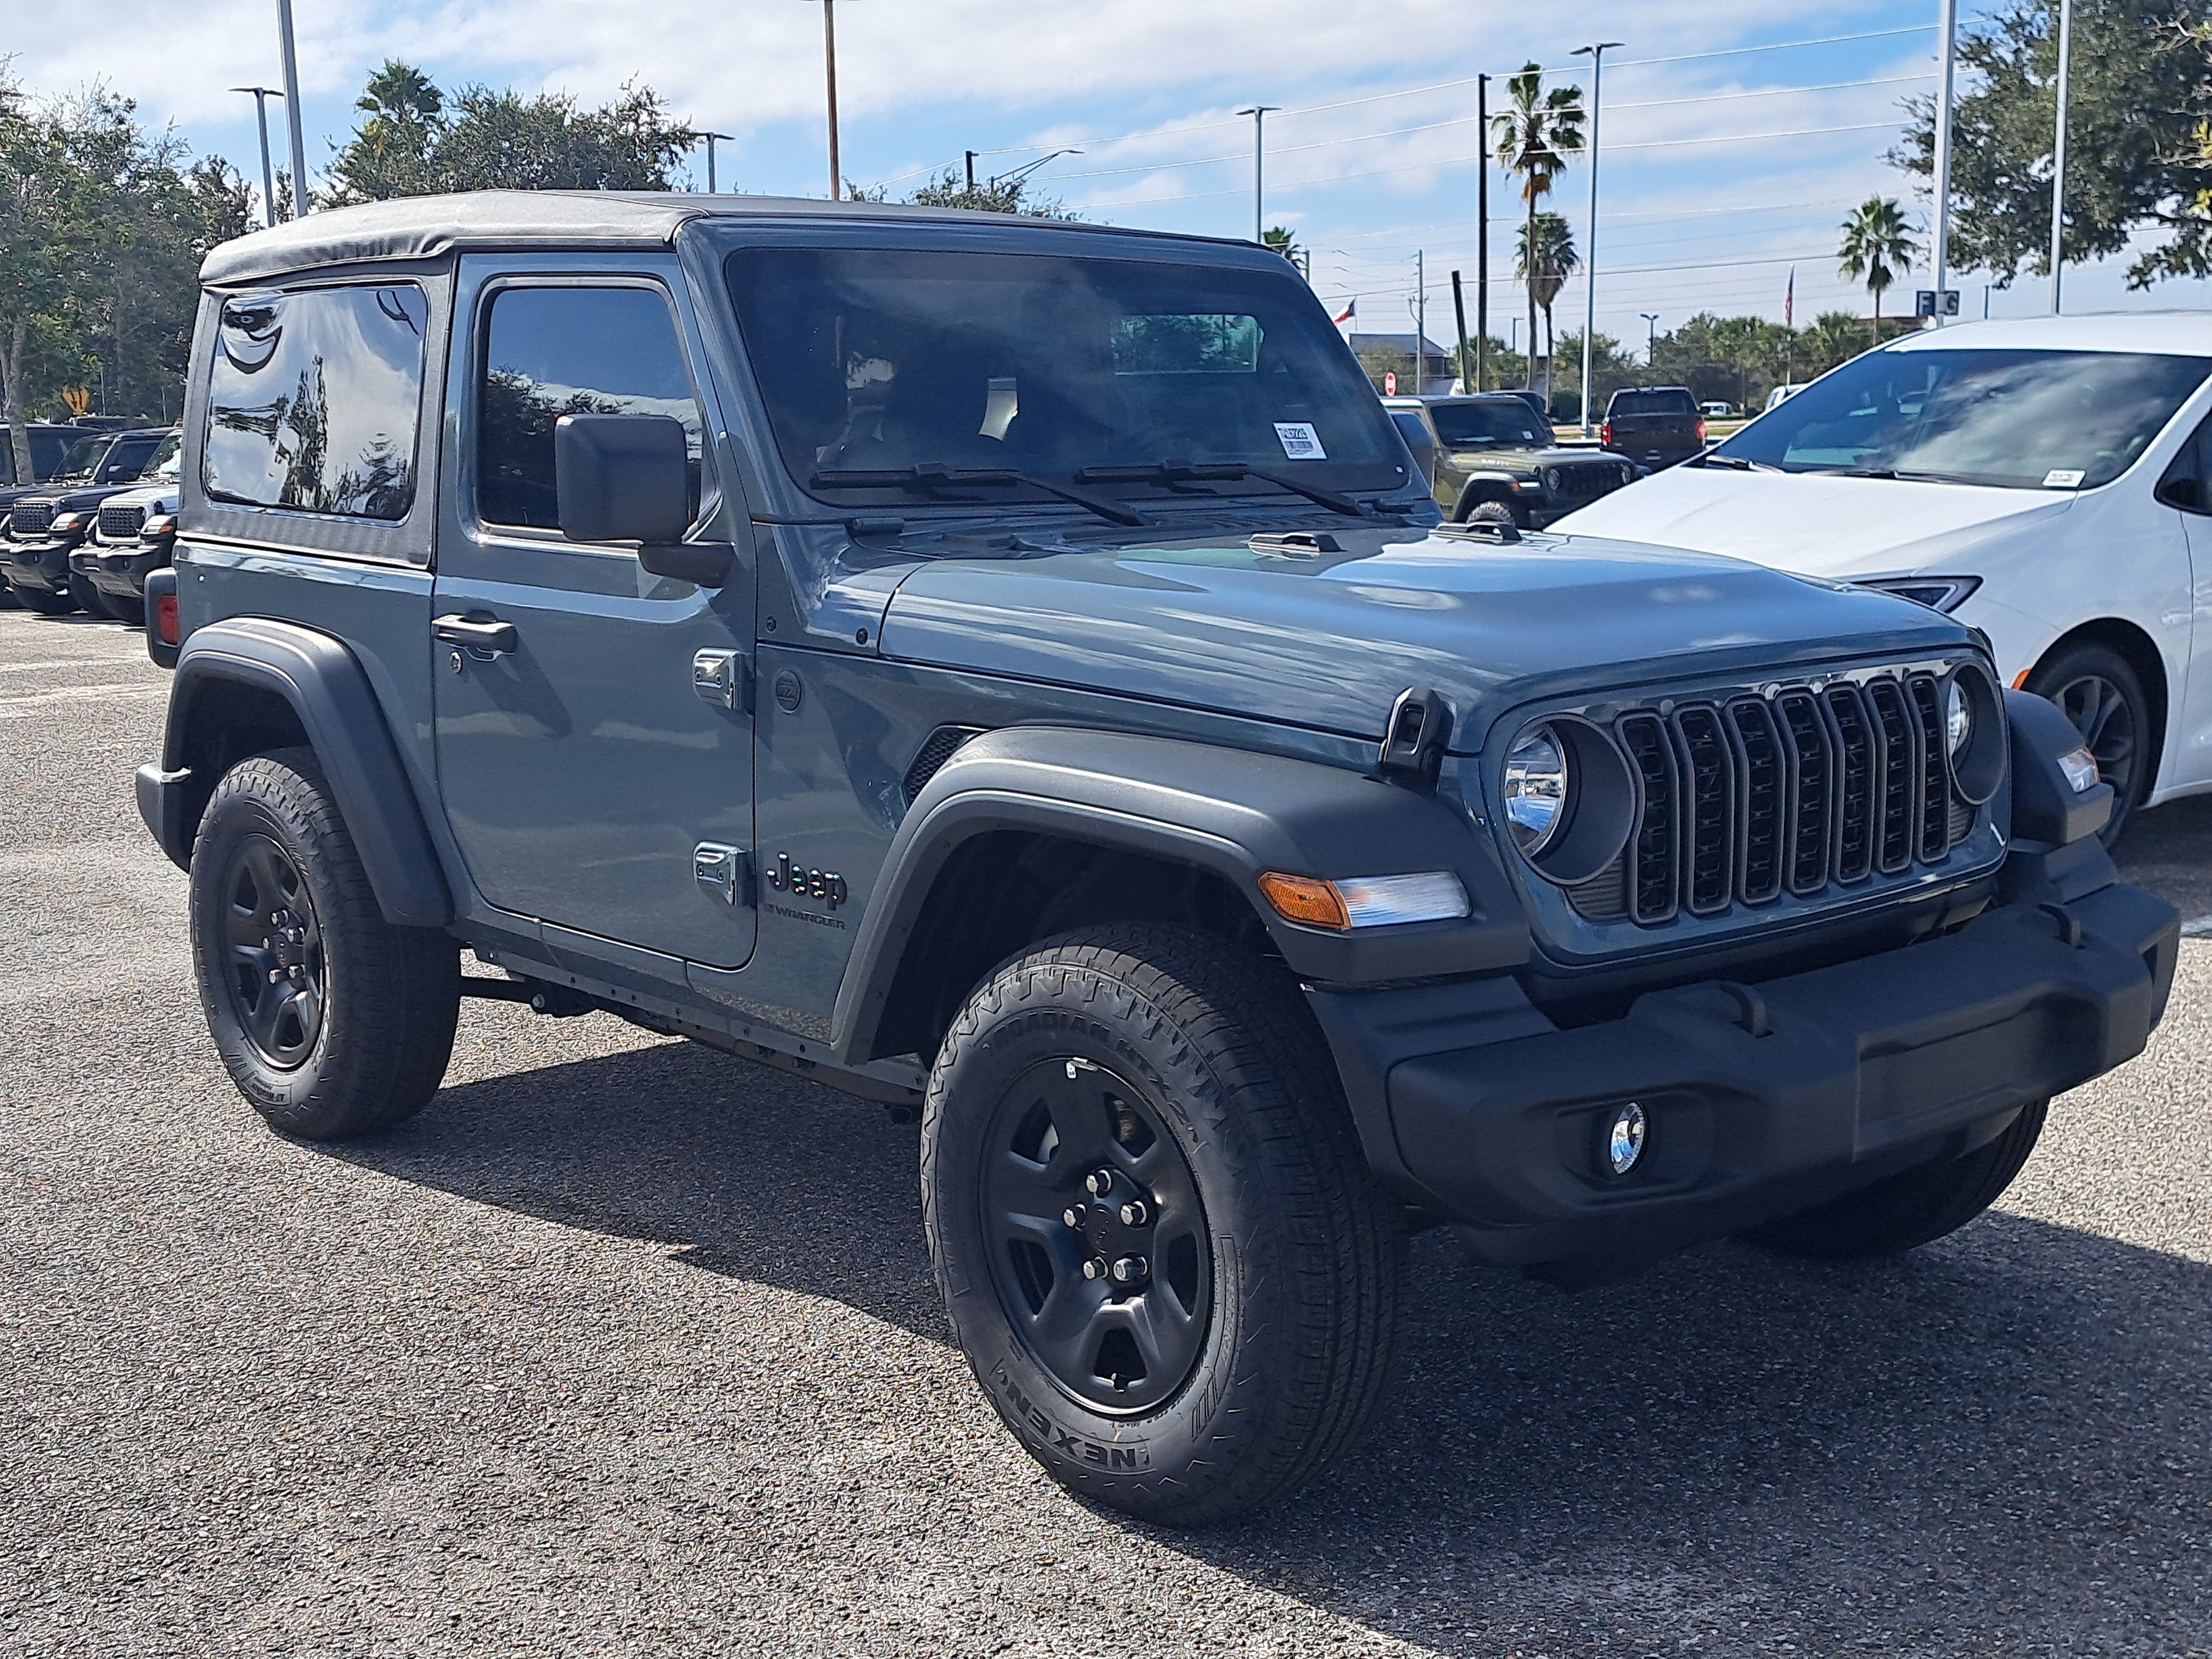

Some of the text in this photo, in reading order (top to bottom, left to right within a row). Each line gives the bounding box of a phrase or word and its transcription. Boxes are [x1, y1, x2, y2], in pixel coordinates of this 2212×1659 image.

[1919, 292, 1931, 314] F
[1946, 292, 1958, 314] G
[765, 851, 848, 911] Jeep
[774, 905, 846, 929] WRANGLER
[1005, 1381, 1135, 1469] NEXEN
